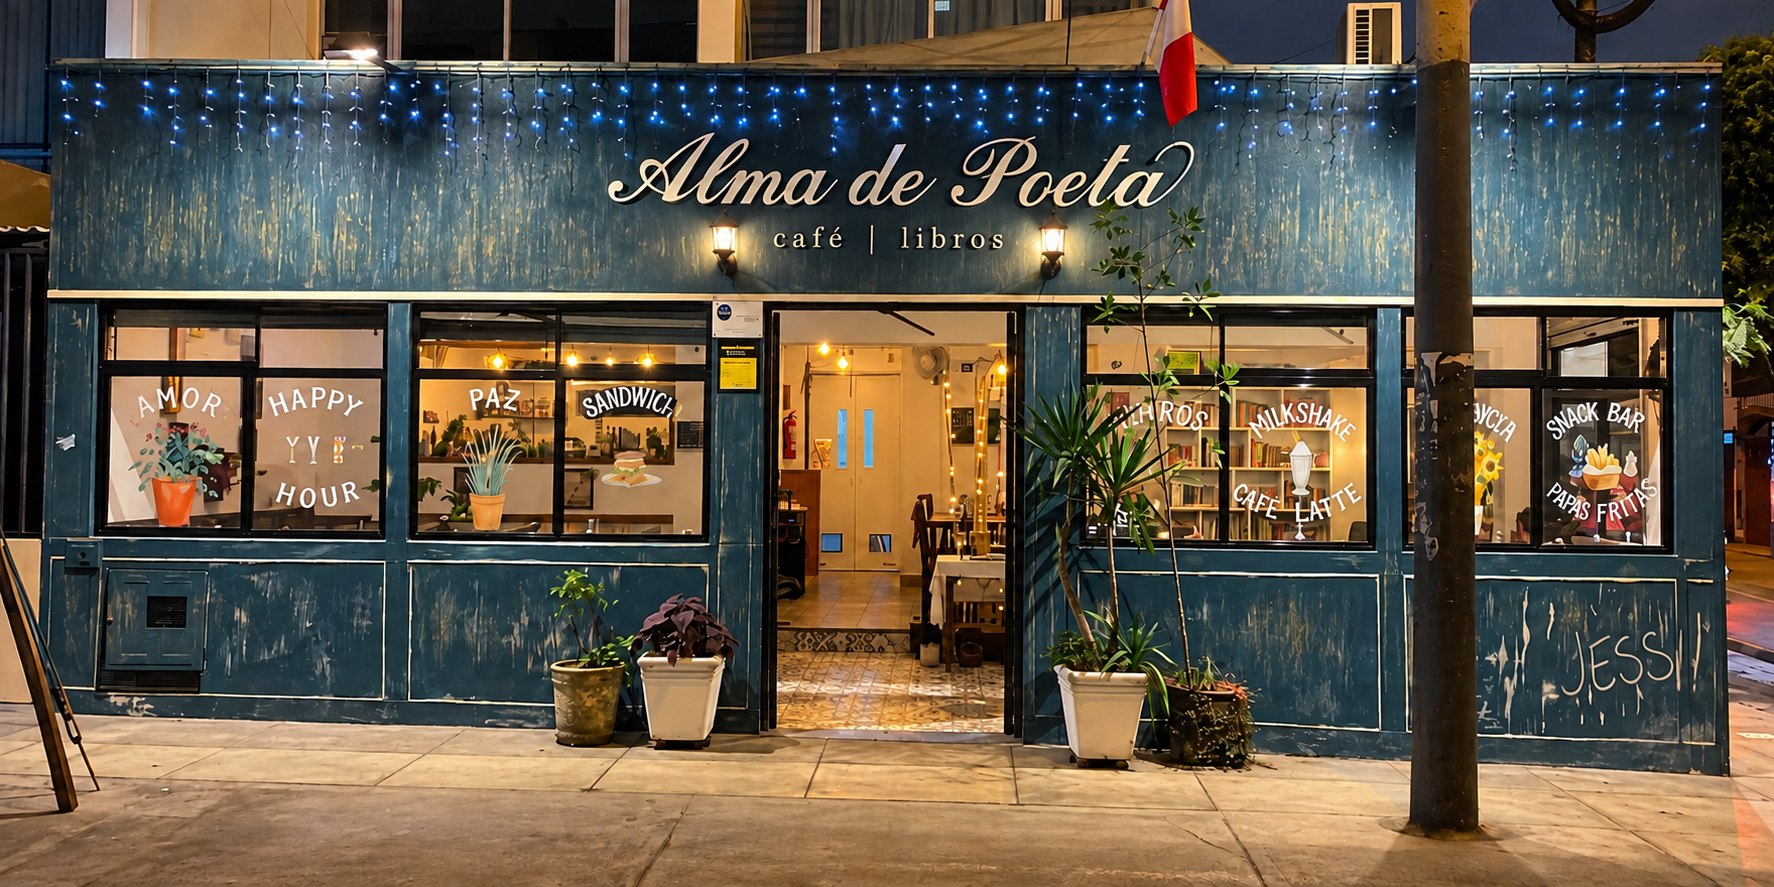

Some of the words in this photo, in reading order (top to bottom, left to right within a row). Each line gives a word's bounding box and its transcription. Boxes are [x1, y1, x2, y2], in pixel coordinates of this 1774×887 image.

[607, 132, 839, 206] Alma
[848, 143, 937, 207] de
[950, 136, 1195, 207] Poeta
[773, 225, 843, 249] café
[900, 225, 1005, 250] libros
[137, 386, 222, 418] AMOR
[268, 386, 364, 417] HAPPY
[469, 387, 521, 411] PAZ
[582, 386, 673, 418] SANDWICH
[1248, 402, 1357, 443] MILKSHAKE
[1546, 402, 1600, 441] SNACK
[1607, 402, 1645, 434] BAR
[275, 481, 360, 509] HOUR
[1295, 482, 1362, 523] LATTE
[1546, 482, 1591, 520] PAPAS
[1597, 477, 1658, 523] FRITAS
[1561, 631, 1674, 697] JESS
